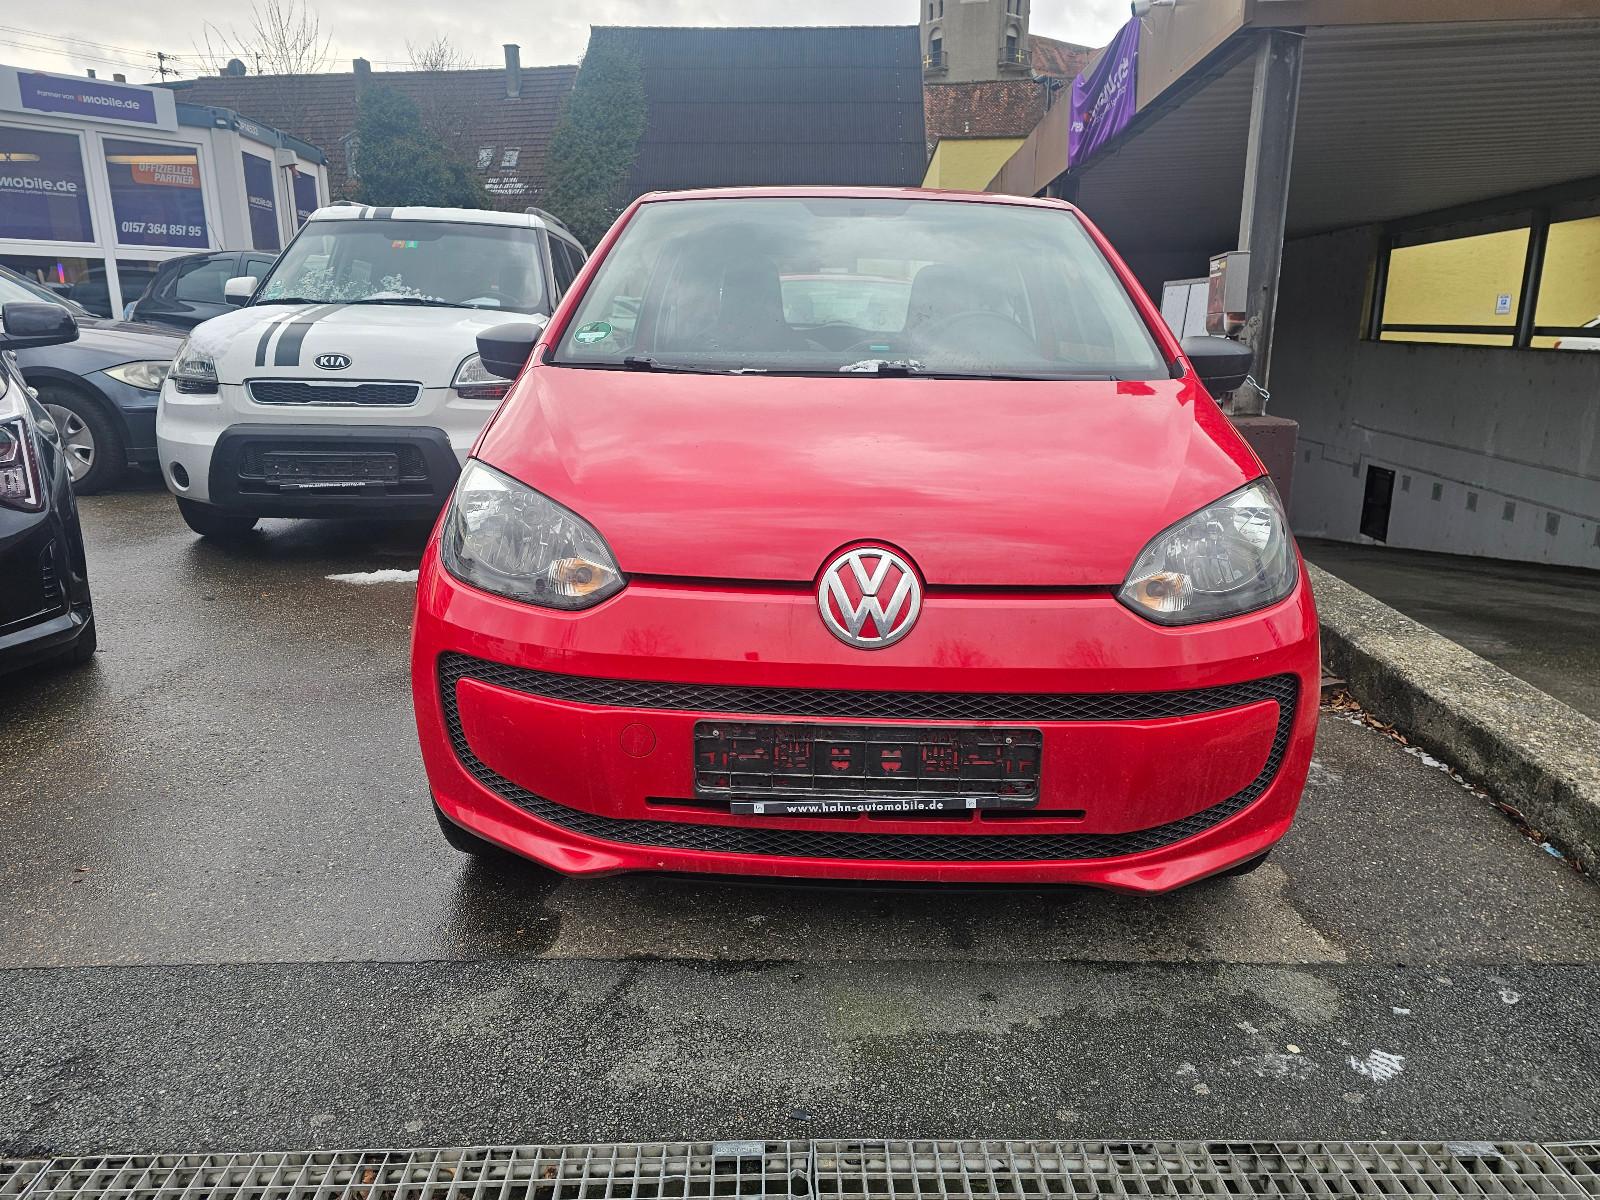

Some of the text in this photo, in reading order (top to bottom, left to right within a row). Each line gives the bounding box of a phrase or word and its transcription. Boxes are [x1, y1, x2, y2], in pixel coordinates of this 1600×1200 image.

[82, 94, 140, 110] mobile.de
[138, 162, 193, 176] OFFIZIELLER
[0, 175, 77, 192] mobile.de
[154, 173, 194, 185] PARTNER
[121, 221, 202, 237] 0157 364 851 95
[320, 356, 346, 366] KIA
[821, 549, 919, 646] VW
[786, 800, 945, 813] www.hahn-automobile.de
